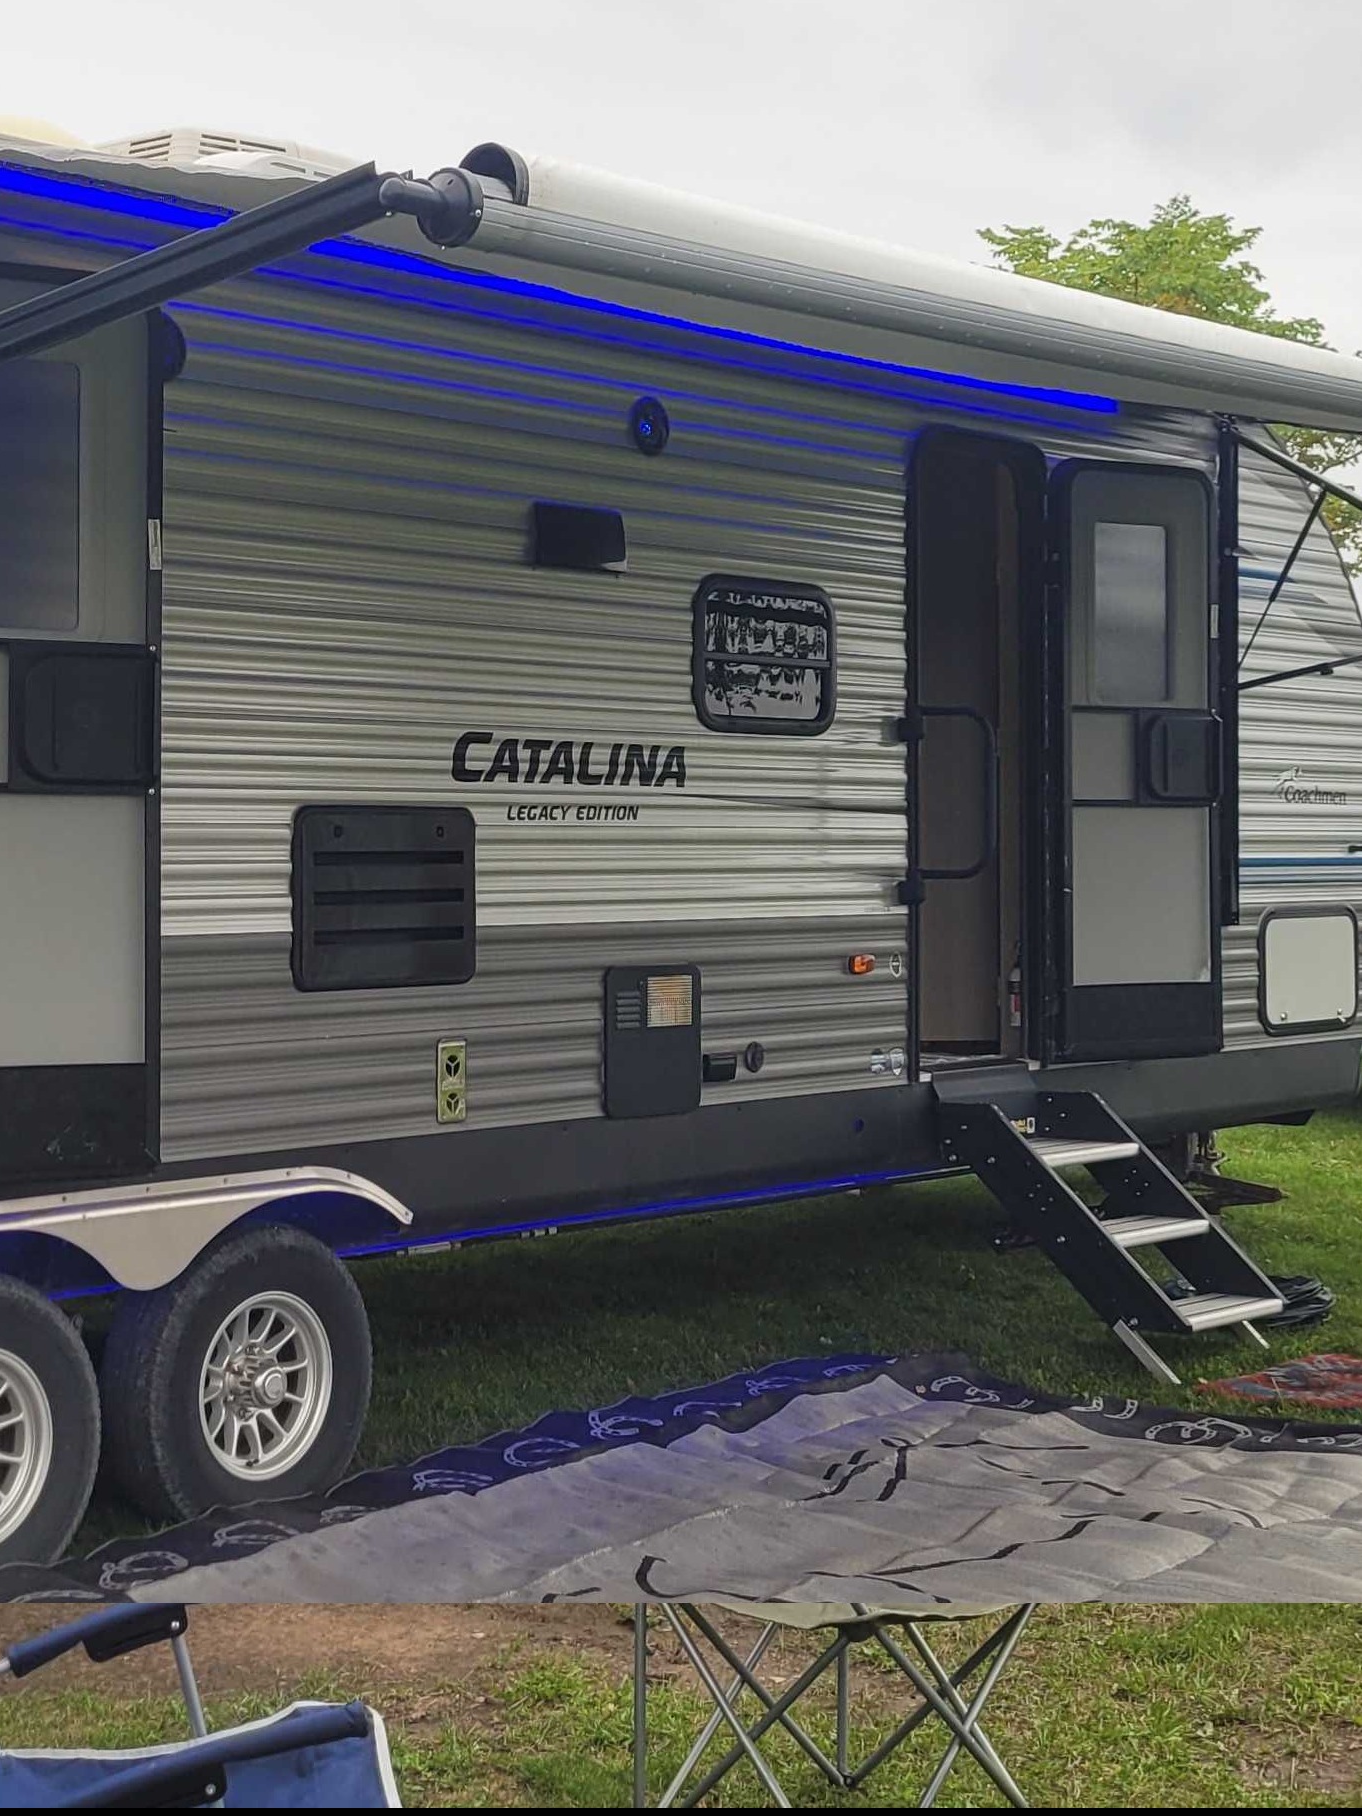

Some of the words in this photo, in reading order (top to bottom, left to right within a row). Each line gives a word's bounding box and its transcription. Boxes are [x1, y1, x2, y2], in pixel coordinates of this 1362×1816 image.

[451, 731, 686, 787] CATALINA
[1284, 785, 1347, 805] Coachmen
[506, 804, 572, 821] LEGACY
[575, 804, 640, 821] EDITION
